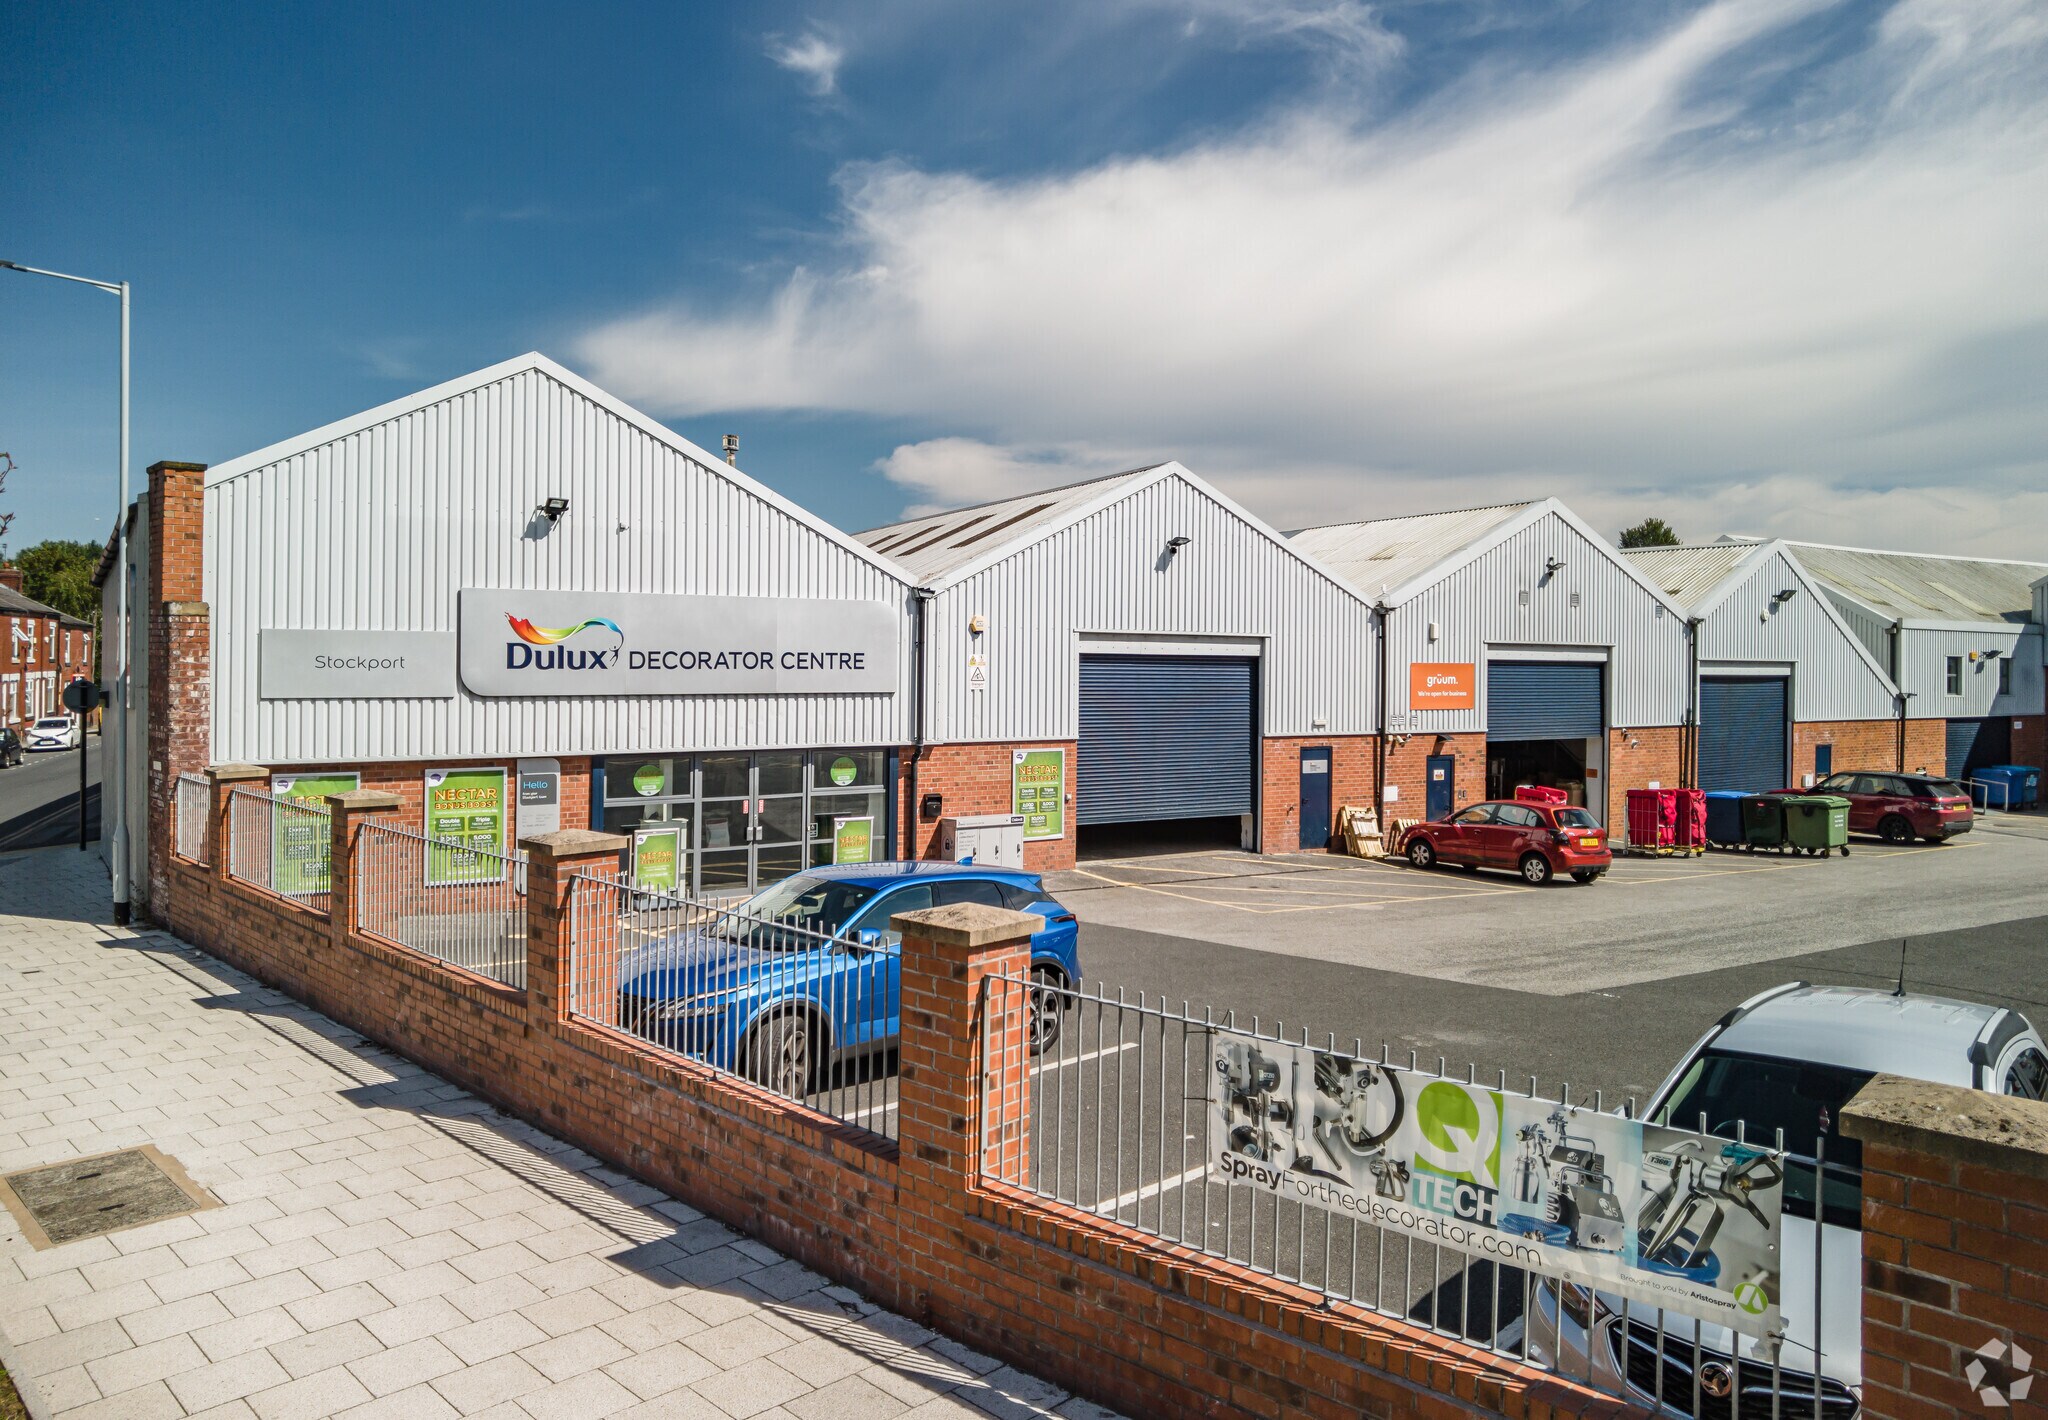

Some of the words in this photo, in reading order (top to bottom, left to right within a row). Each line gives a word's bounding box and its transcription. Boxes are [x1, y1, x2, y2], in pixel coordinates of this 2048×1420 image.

[314, 654, 406, 672] Stockport
[506, 642, 607, 671] Dulux
[629, 650, 773, 671] DECORATOR
[780, 651, 865, 671] CENTRE
[1018, 765, 1058, 775] NECTAR
[523, 781, 548, 789] Hello
[435, 788, 498, 801] NECTAR
[435, 802, 466, 810] BONUS
[467, 800, 498, 809] BOOST
[1413, 1173, 1498, 1226] TECH
[1620, 1273, 1651, 1287] Brought
[1652, 1280, 1661, 1290] to
[1662, 1284, 1677, 1293] you
[1678, 1286, 1690, 1297] by
[1690, 1291, 1737, 1310] Aristospray
